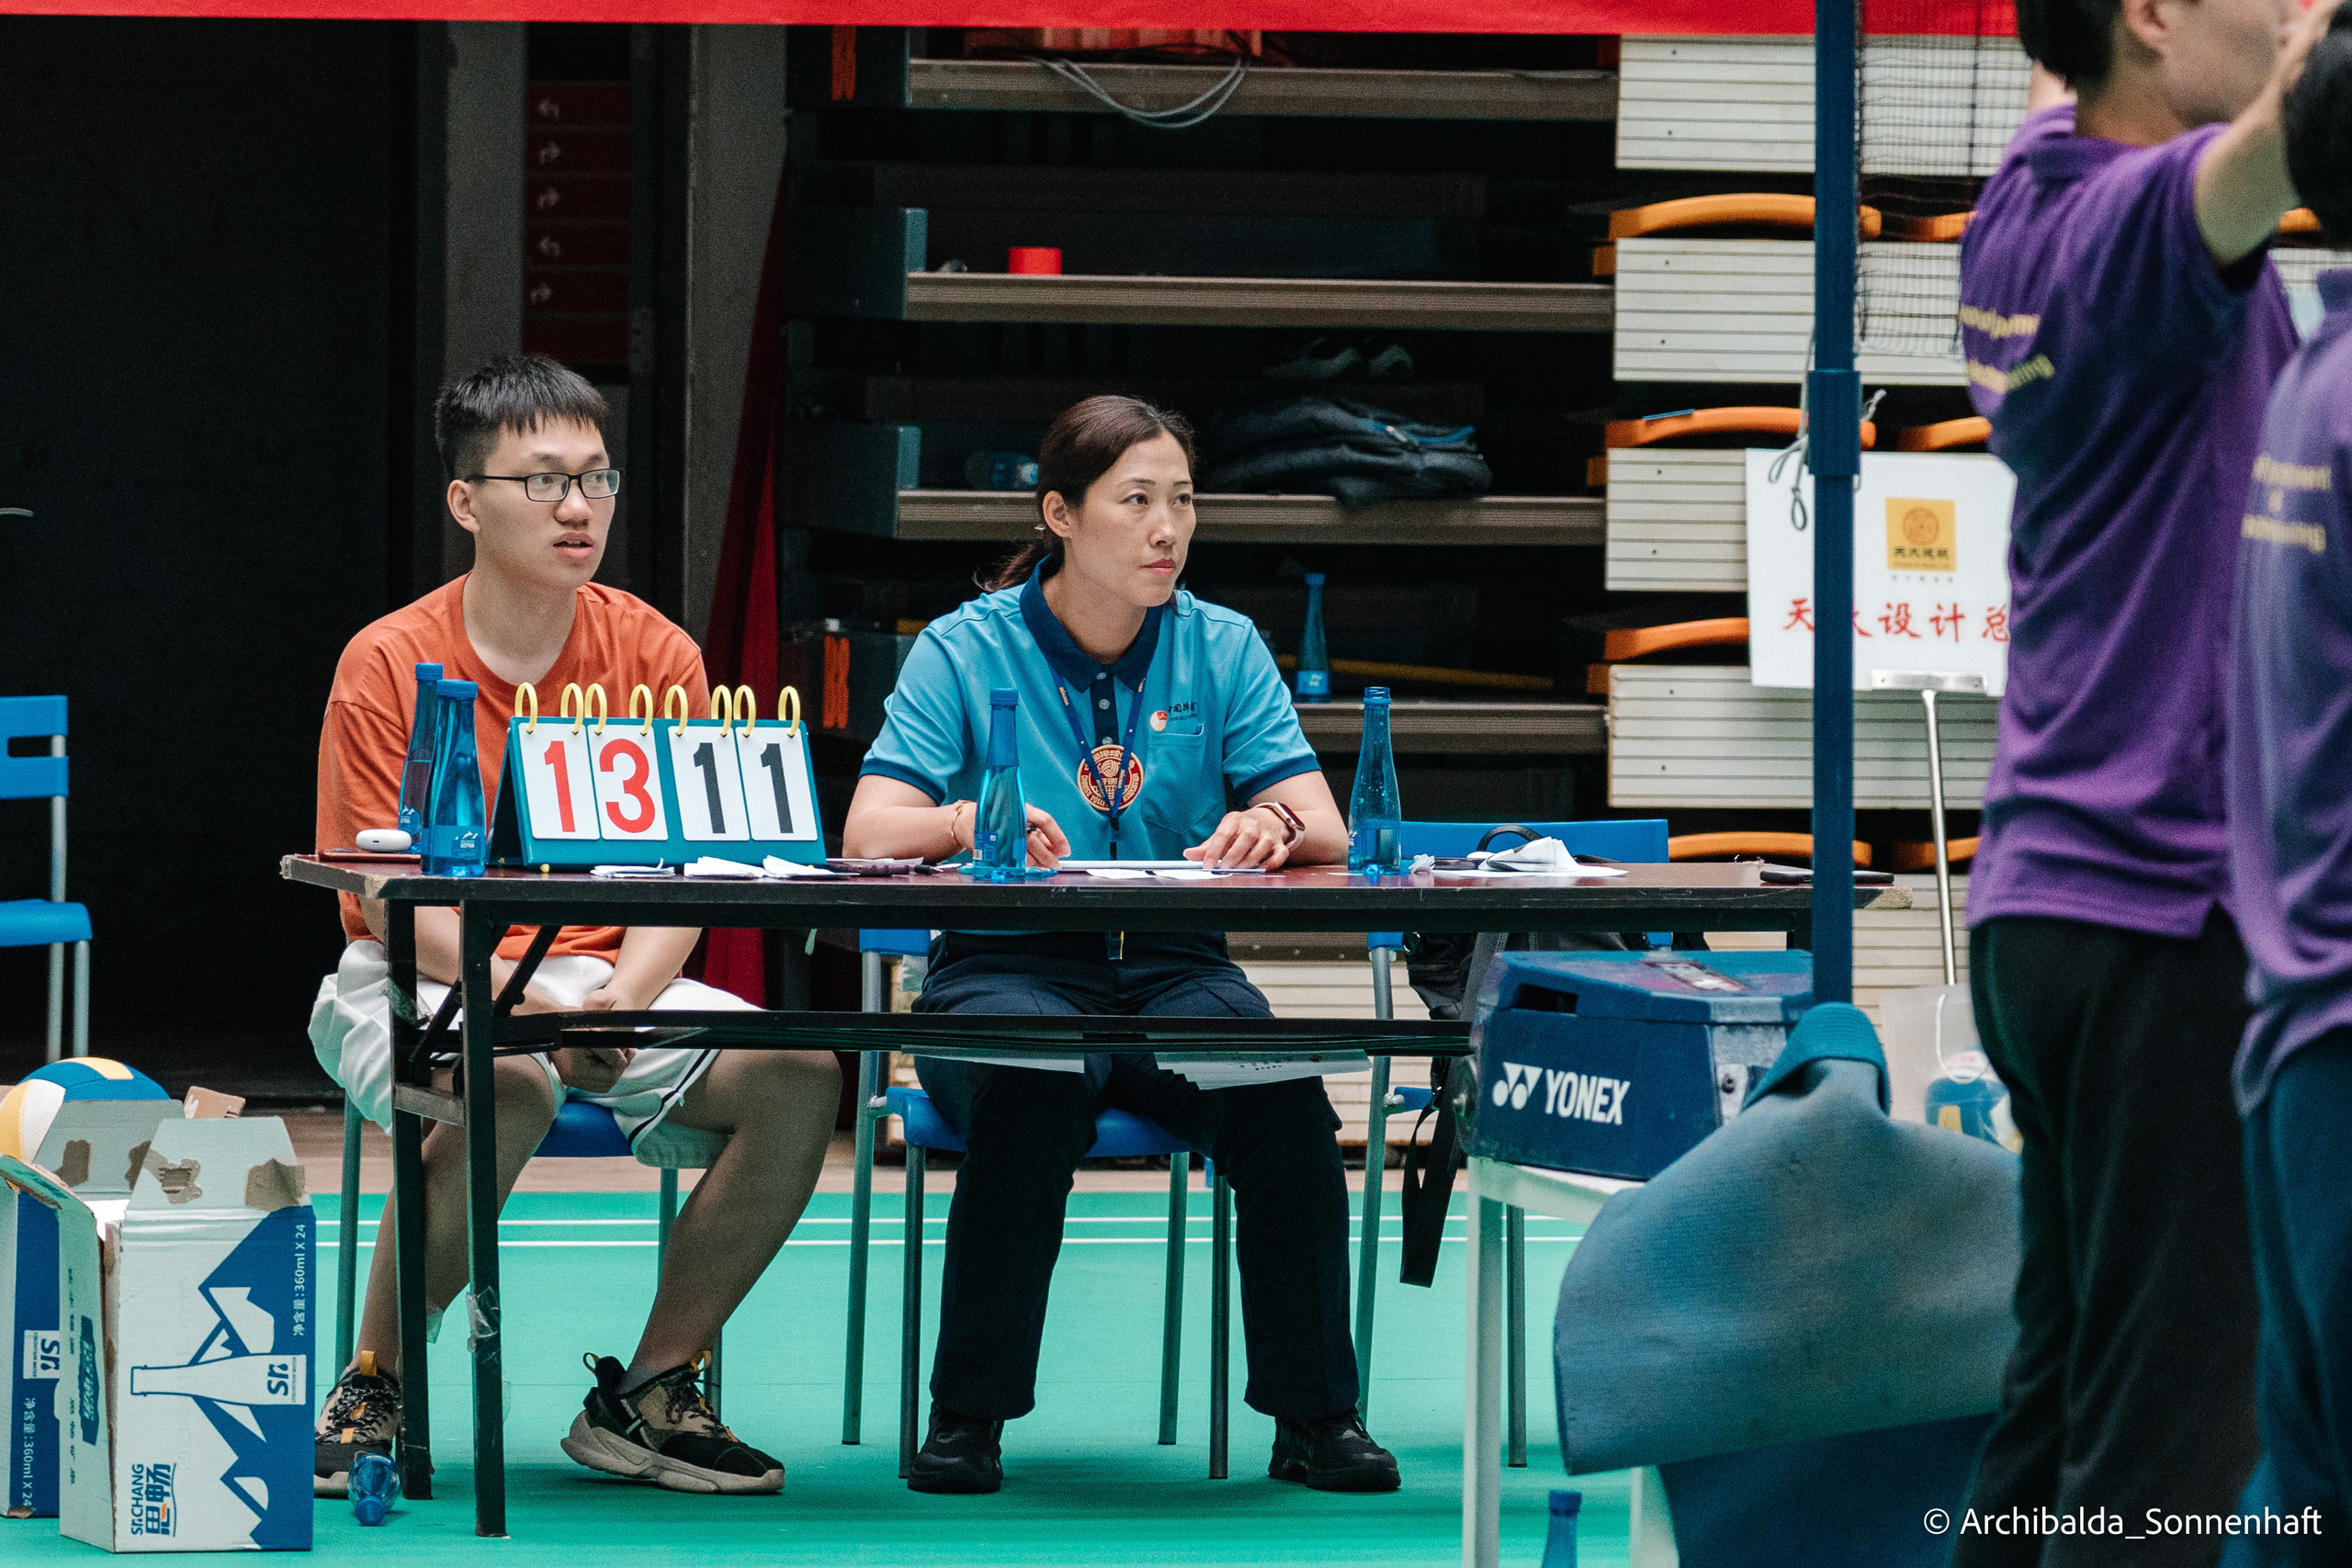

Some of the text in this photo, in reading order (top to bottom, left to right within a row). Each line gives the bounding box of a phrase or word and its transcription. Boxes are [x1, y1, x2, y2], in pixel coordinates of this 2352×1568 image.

[1545, 1068, 1631, 1126] YONEX
[295, 1224, 306, 1239] 24
[293, 1253, 306, 1337] 净含量:360ml
[22, 1492, 33, 1507] 24
